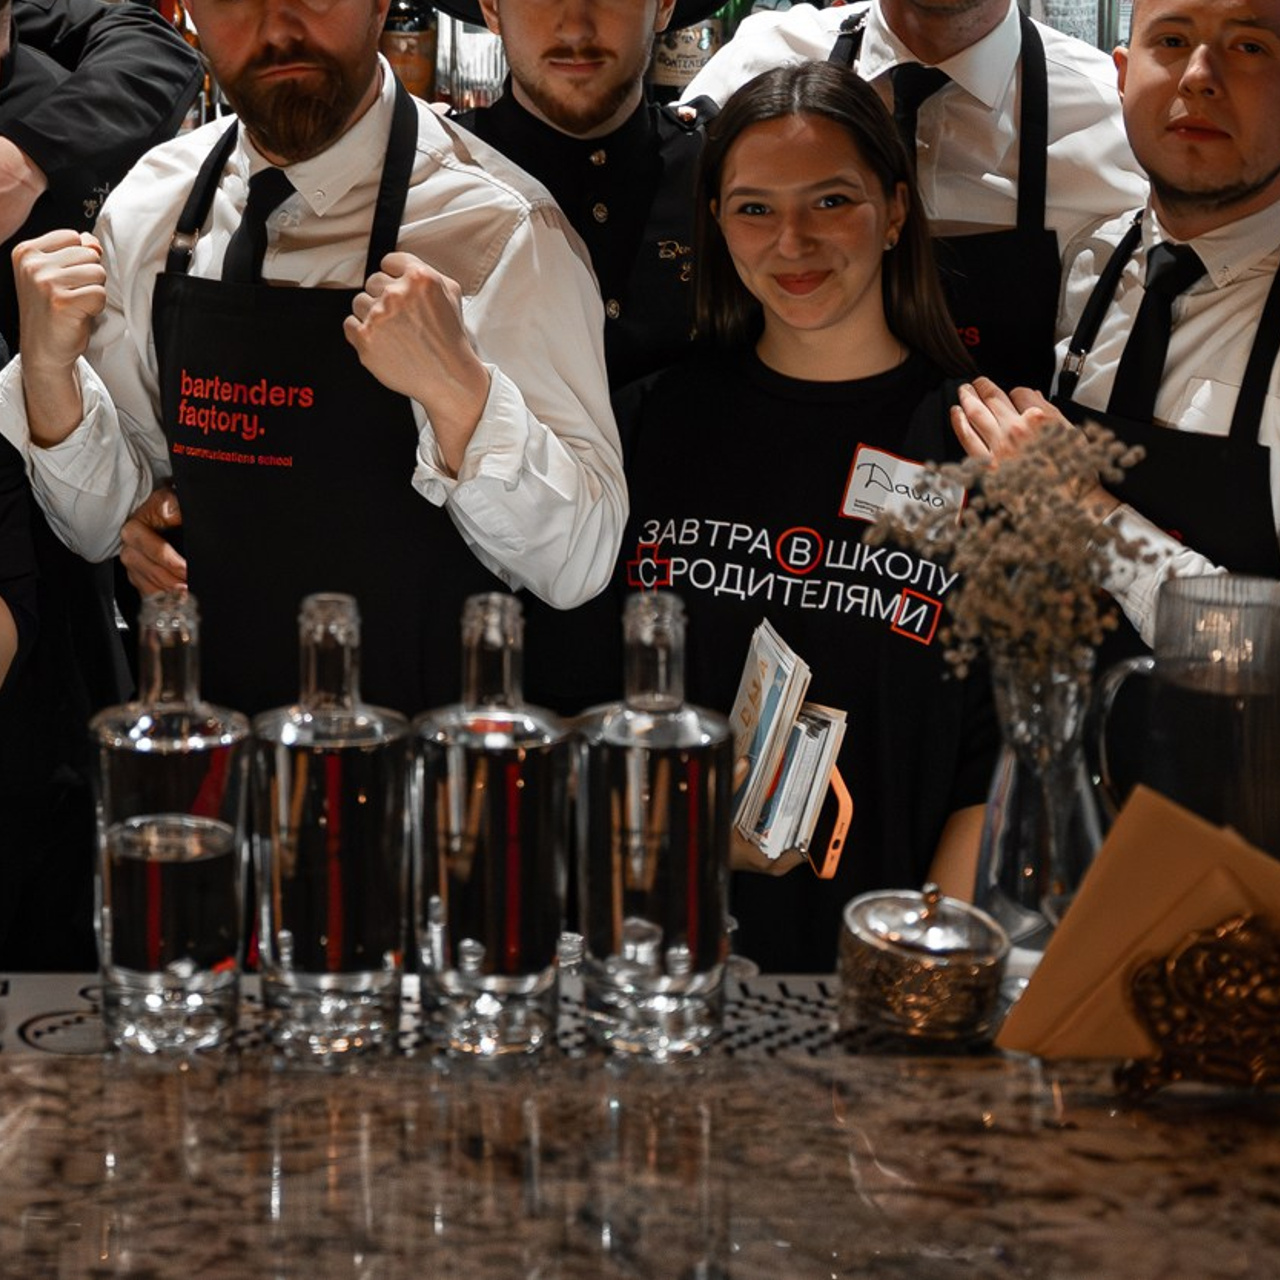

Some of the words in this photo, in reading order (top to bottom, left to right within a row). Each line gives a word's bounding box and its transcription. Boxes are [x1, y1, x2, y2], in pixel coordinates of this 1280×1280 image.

[180, 368, 315, 408] bartenders
[178, 398, 266, 441] faqtory.
[258, 455, 293, 467] school
[637, 518, 773, 560] ЗАВТРА
[789, 536, 812, 567] В
[824, 539, 960, 598] ШКОЛУ
[638, 557, 658, 589] С
[668, 557, 929, 634] РОДИТЕЛЯМИ
